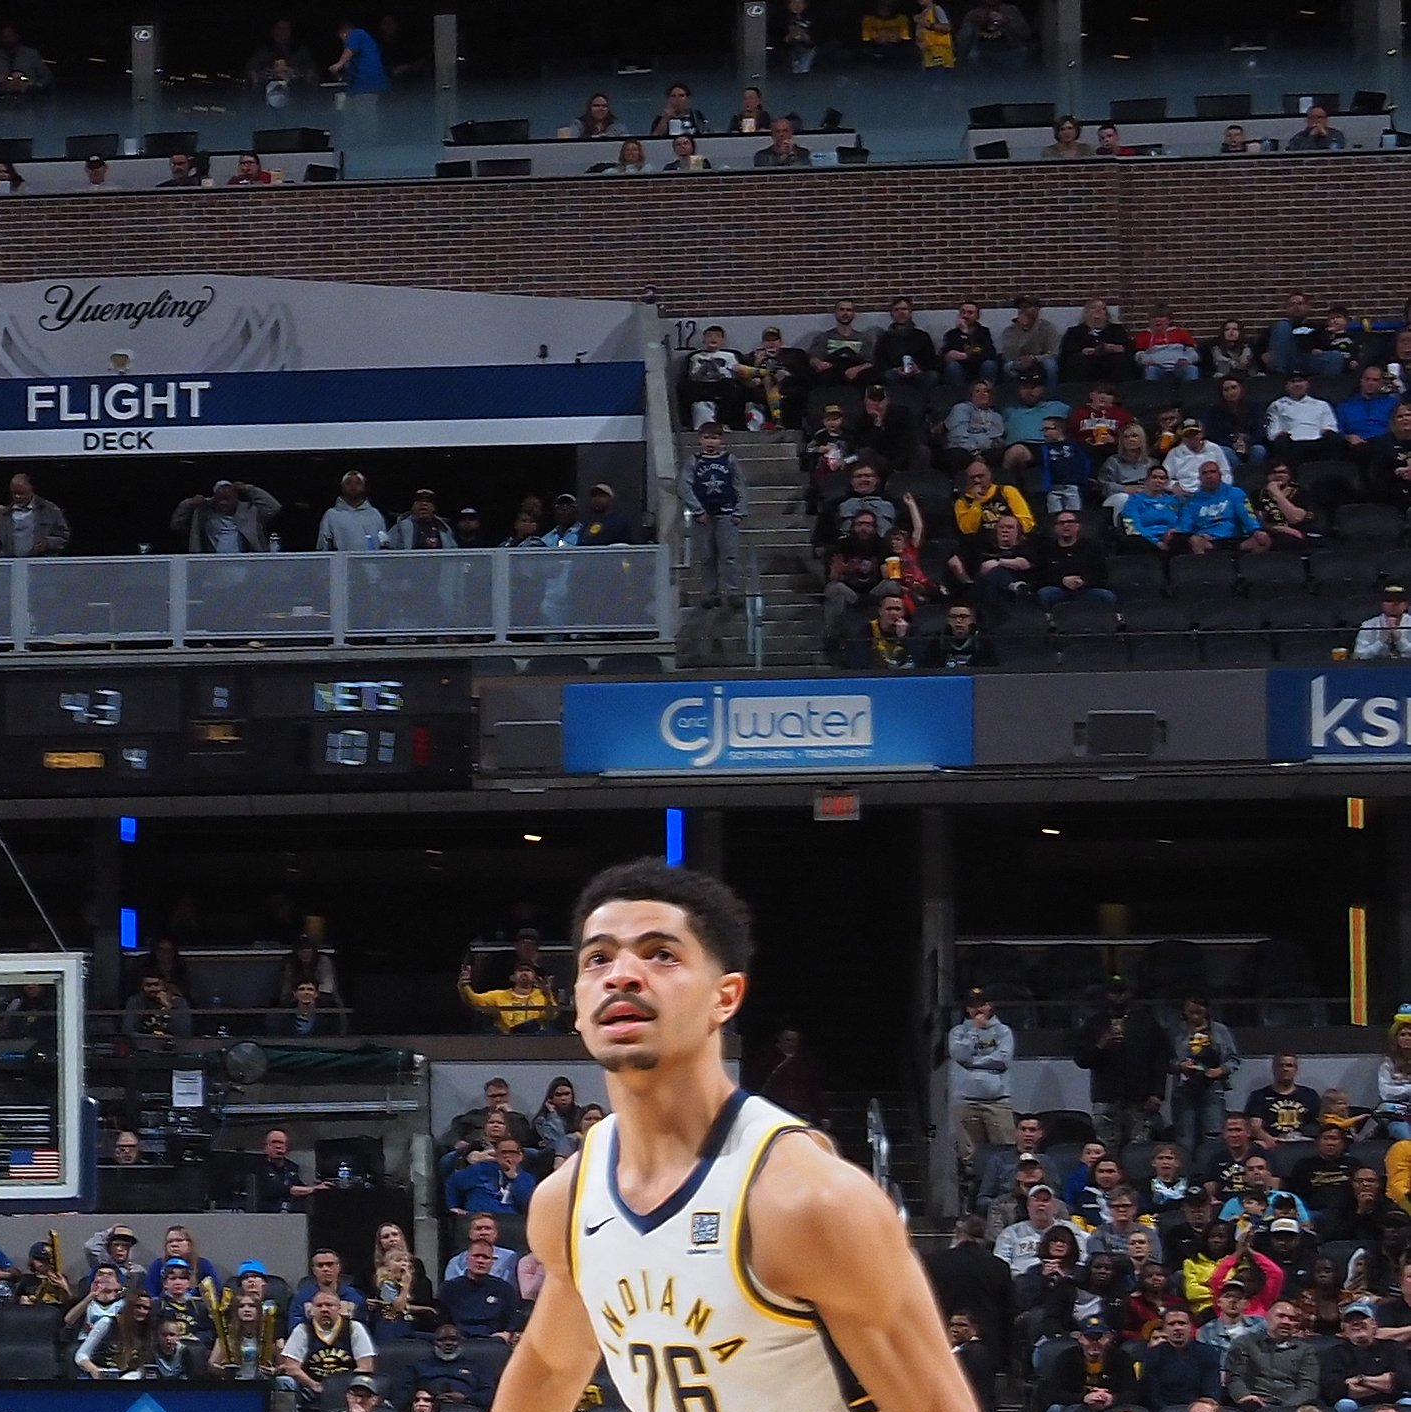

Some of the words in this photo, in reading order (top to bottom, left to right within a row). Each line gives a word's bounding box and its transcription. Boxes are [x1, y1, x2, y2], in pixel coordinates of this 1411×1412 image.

[38, 284, 216, 332] Yuengling
[672, 321, 695, 351] 12
[27, 381, 211, 422] FLIGHT
[83, 431, 154, 450] DECK
[733, 701, 866, 738] water
[1310, 674, 1411, 748] ks
[600, 1268, 750, 1364] INDIANA
